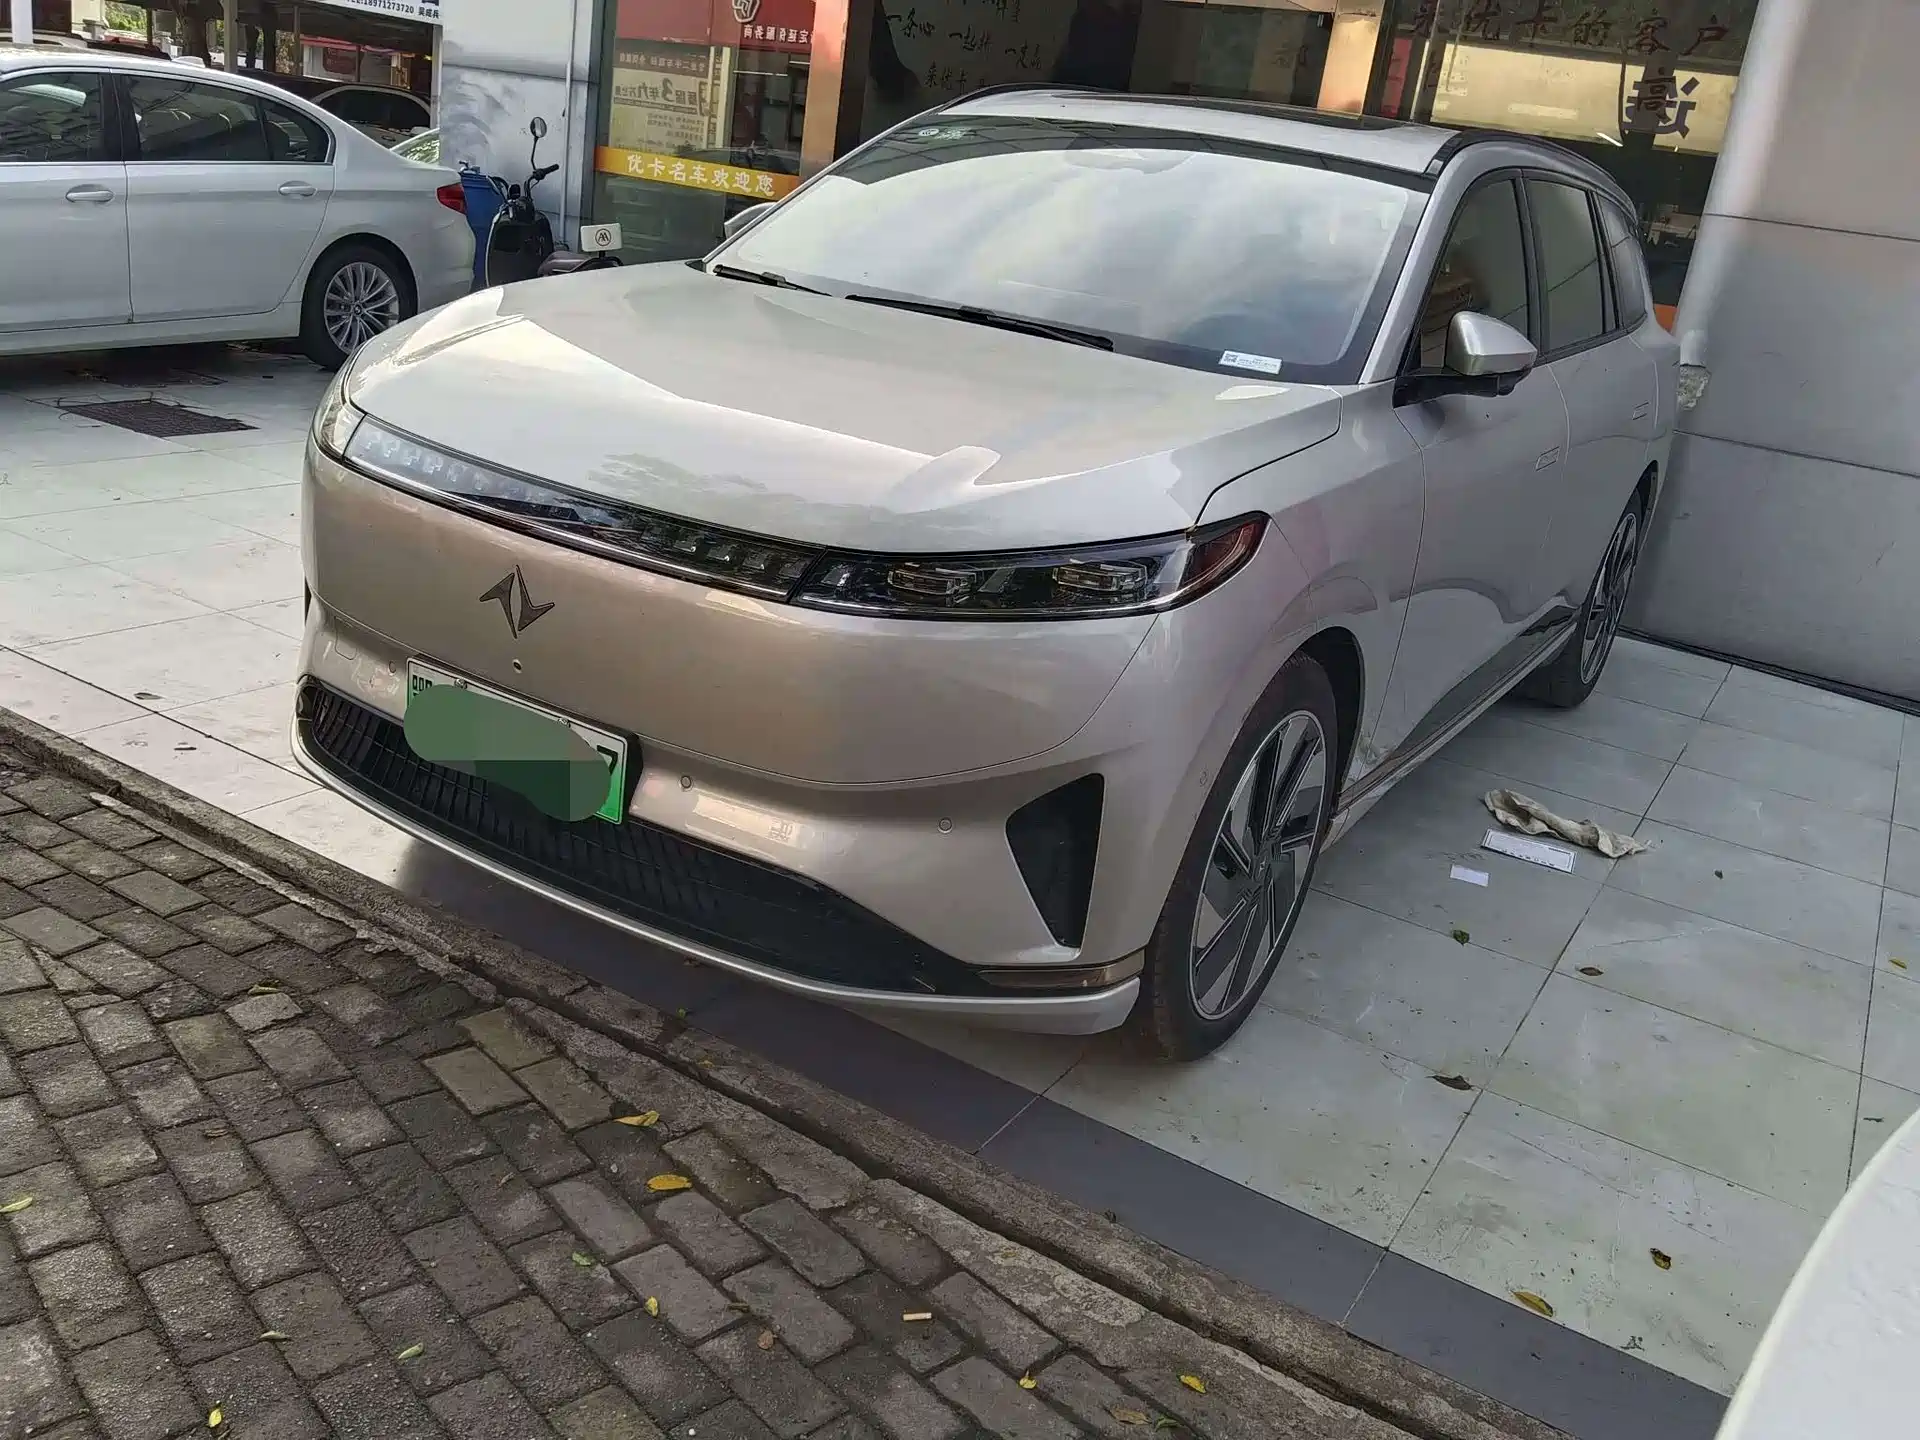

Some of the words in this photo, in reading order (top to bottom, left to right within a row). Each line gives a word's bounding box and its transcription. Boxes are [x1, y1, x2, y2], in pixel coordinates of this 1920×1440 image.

[627, 153, 776, 197] 优卡名车欢迎您
